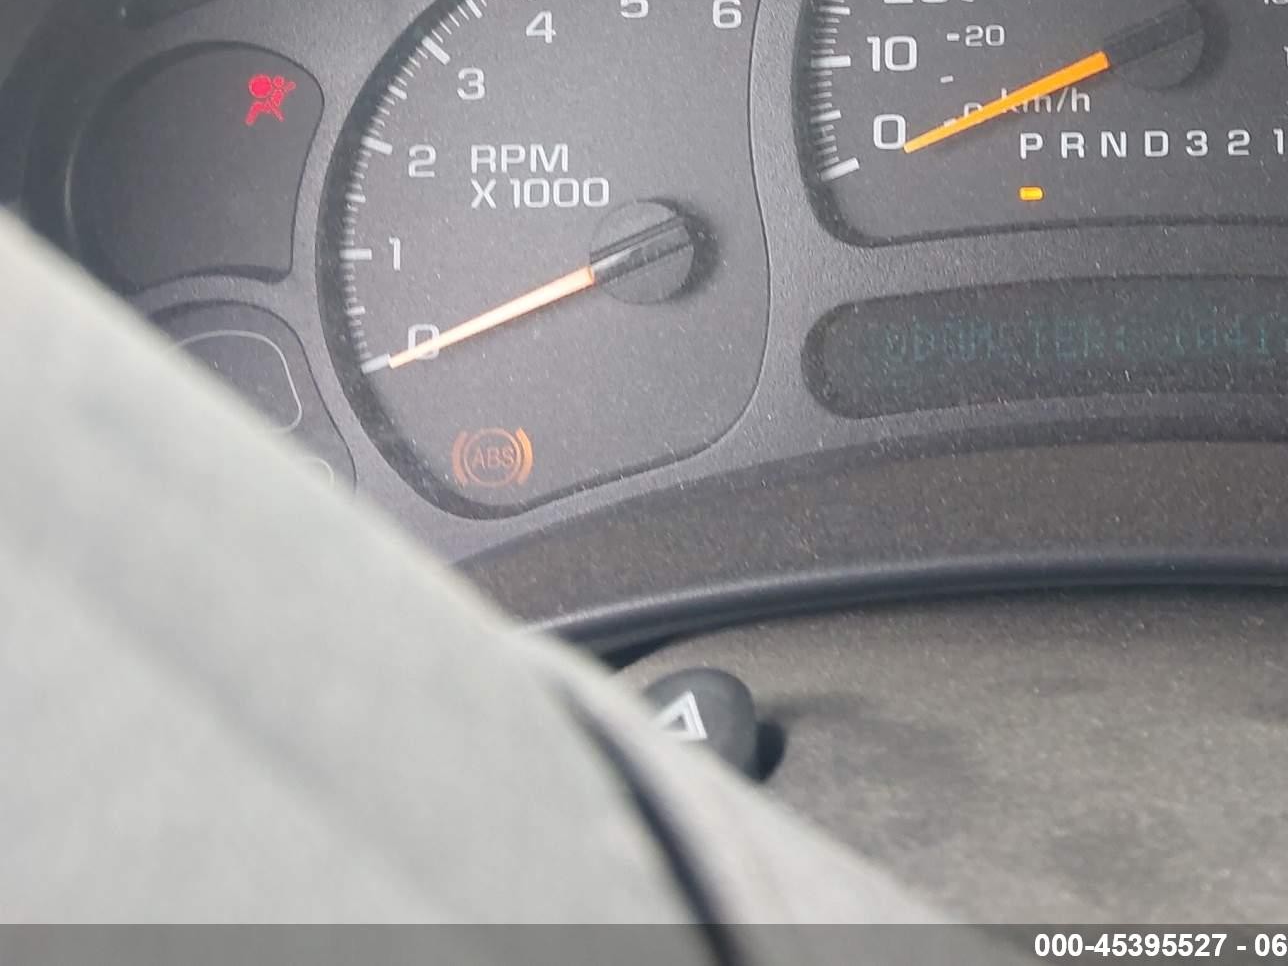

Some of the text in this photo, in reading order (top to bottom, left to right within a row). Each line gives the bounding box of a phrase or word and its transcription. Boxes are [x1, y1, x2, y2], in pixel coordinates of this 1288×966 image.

[526, 11, 556, 44] 4
[965, 25, 1005, 47] 20
[867, 36, 918, 72] 10
[456, 67, 486, 100] 3
[873, 114, 906, 150] 0
[1020, 129, 1284, 159] P R N D 3 2 1
[408, 144, 436, 178] 2
[471, 144, 568, 173] RPM
[471, 178, 610, 208] X 1000
[389, 236, 401, 271] 1
[407, 324, 440, 360] 0
[471, 445, 514, 469] ABS
